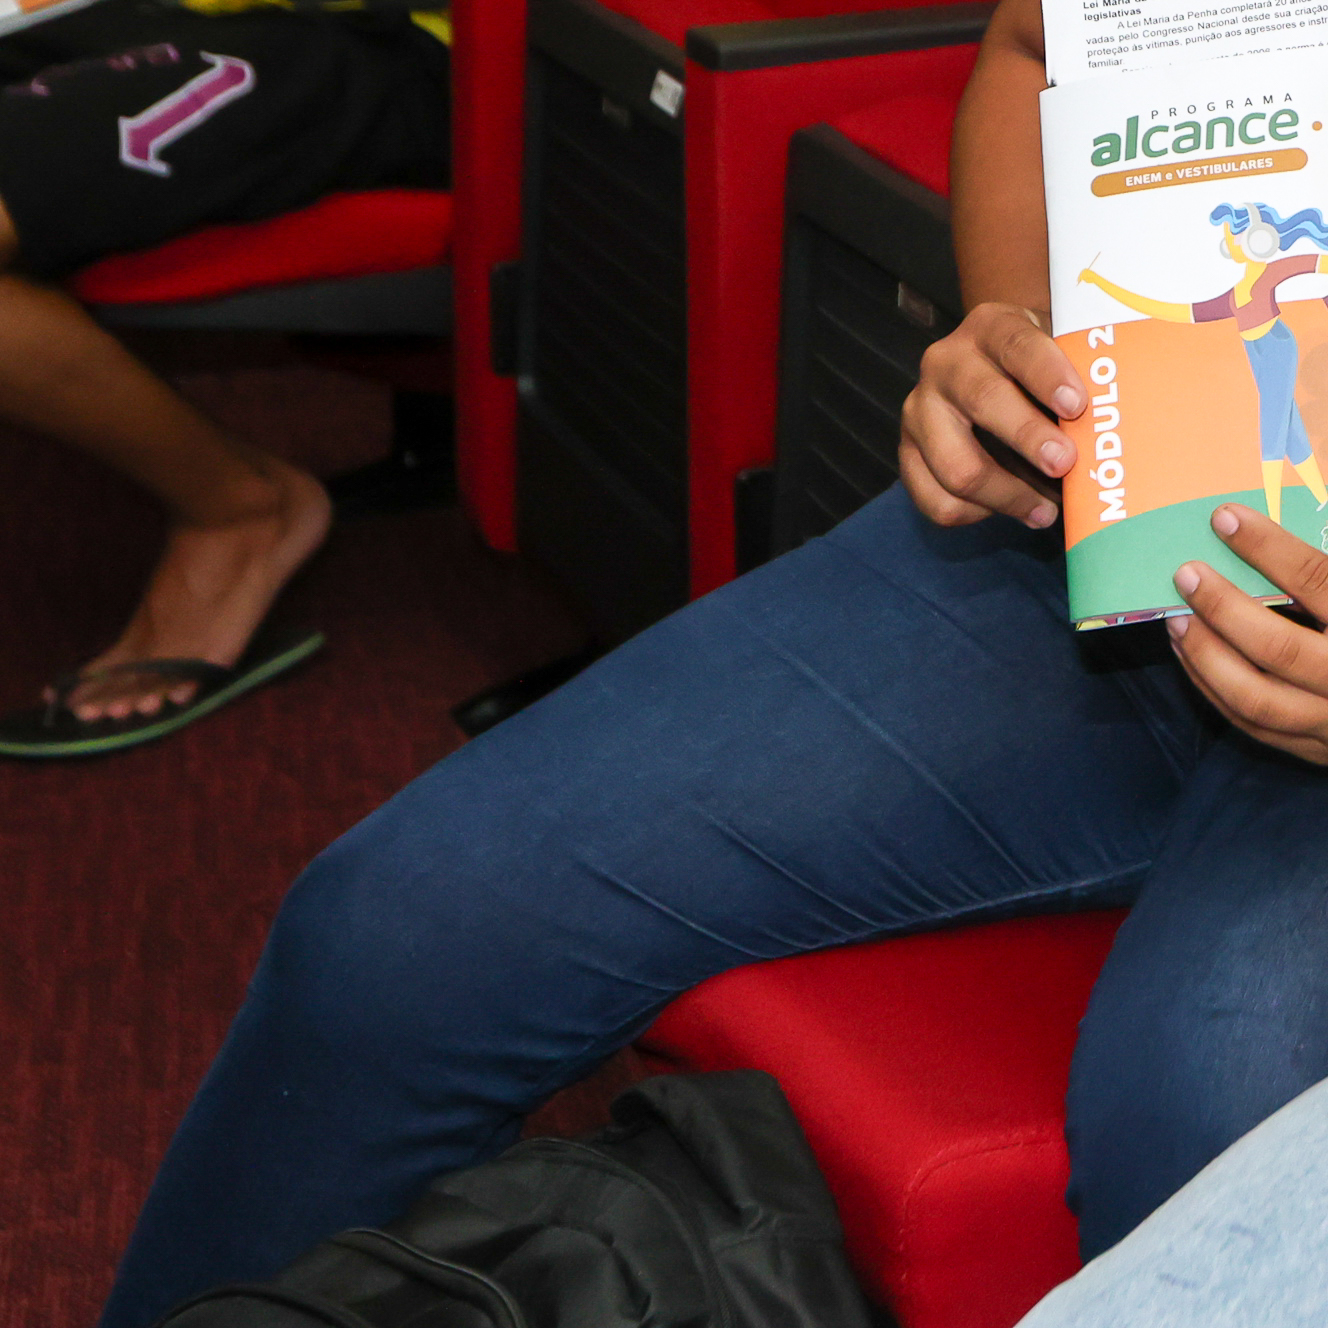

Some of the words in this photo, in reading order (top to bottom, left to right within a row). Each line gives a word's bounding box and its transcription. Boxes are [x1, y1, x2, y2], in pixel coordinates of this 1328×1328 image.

[1083, 0, 1098, 9] Lei
[1084, 8, 1142, 22] legislativas
[1117, 21, 1125, 30] A
[1126, 20, 1141, 28] Lei
[1143, 16, 1170, 26] Maria
[1172, 13, 1185, 22] da
[1187, 9, 1218, 19] Penha
[1220, 0, 1272, 15] completará
[1086, 35, 1115, 45] vadas
[1118, 32, 1139, 43] pelo
[1142, 25, 1194, 38] Congresso
[1197, 16, 1238, 30] Nacional
[1241, 12, 1270, 23] desde
[1274, 10, 1291, 19] sua
[1087, 46, 1129, 58] proteção
[1185, 32, 1222, 45] punição
[1225, 29, 1242, 38] aos
[1244, 22, 1297, 35] agressores
[1299, 20, 1306, 28] e
[1151, 92, 1293, 120] PROGRAMA
[1090, 108, 1299, 167] alcance
[1125, 171, 1162, 187] ENEM
[1165, 172, 1173, 181] e
[1175, 157, 1274, 180] VESTIBULARES
[1087, 324, 1115, 350] 2
[1089, 356, 1127, 522] MÓDULO
